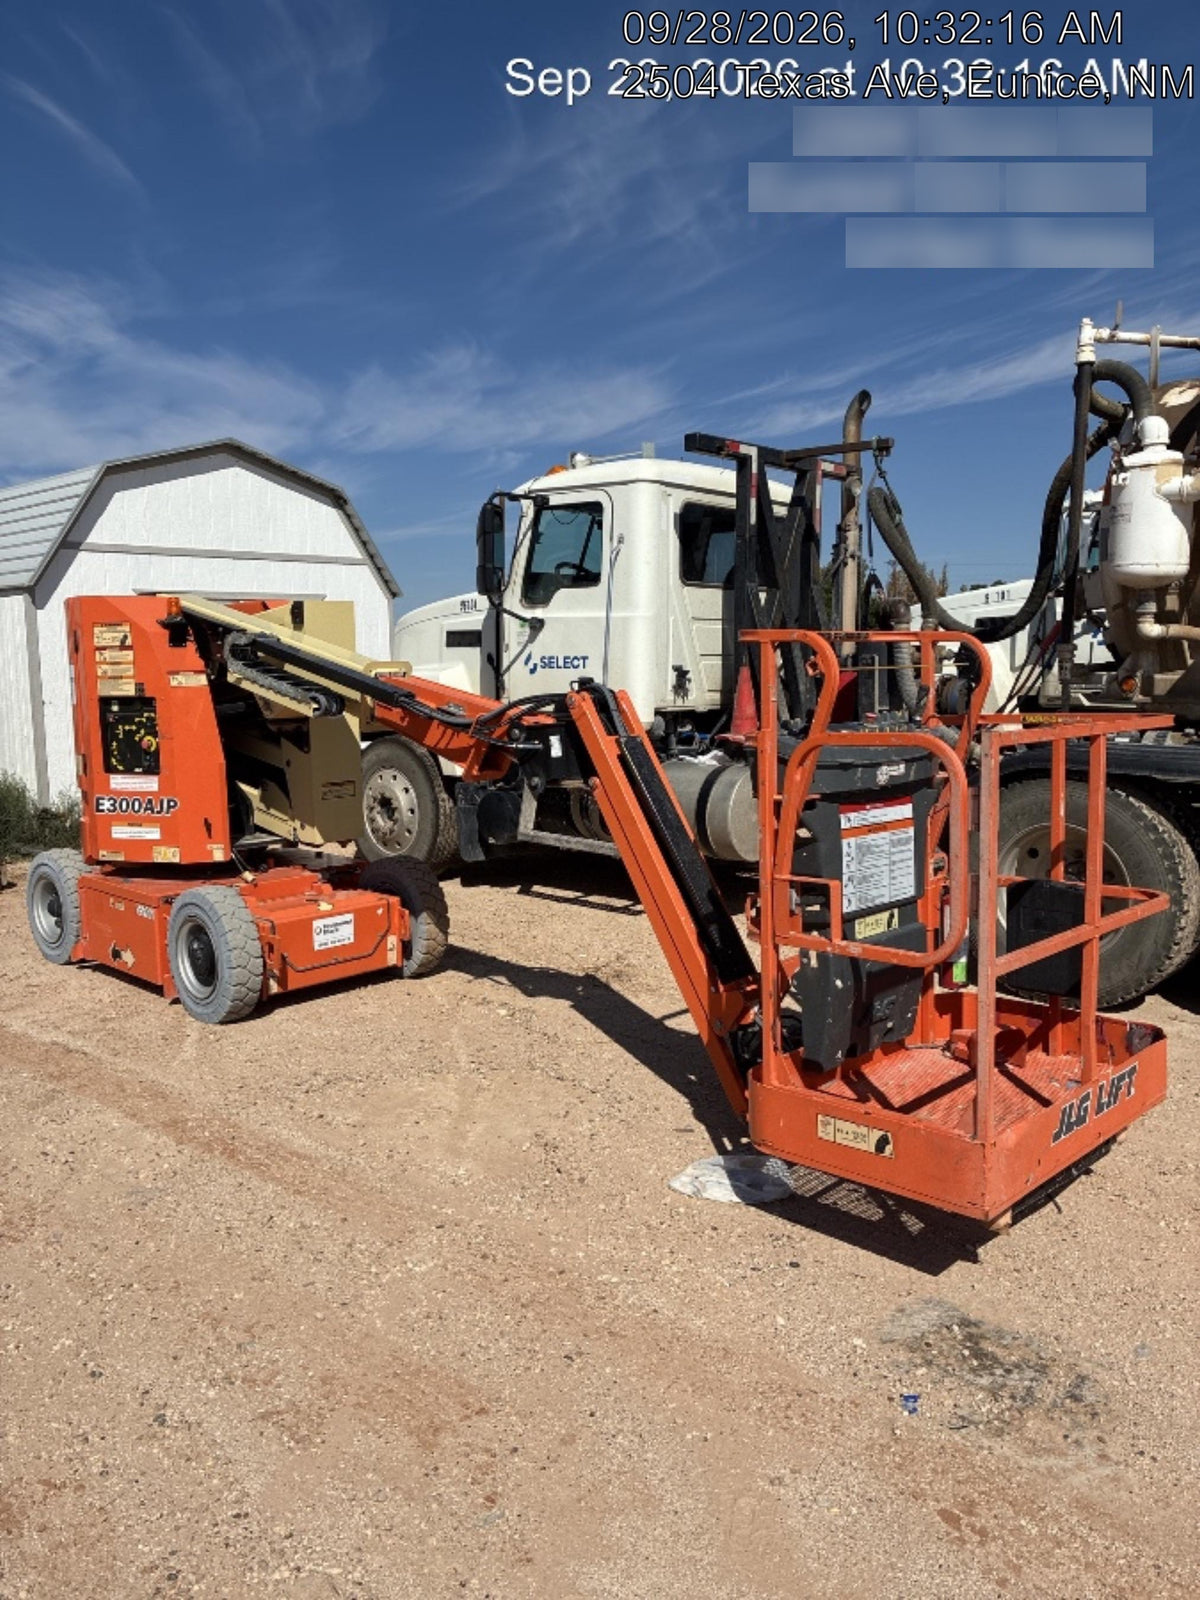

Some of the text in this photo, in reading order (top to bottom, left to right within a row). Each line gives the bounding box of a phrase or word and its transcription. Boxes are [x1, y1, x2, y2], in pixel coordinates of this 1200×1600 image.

[540, 655, 589, 669] SELECT
[95, 795, 179, 816] E300AJP
[1051, 1061, 1139, 1147] JLG LIFT
